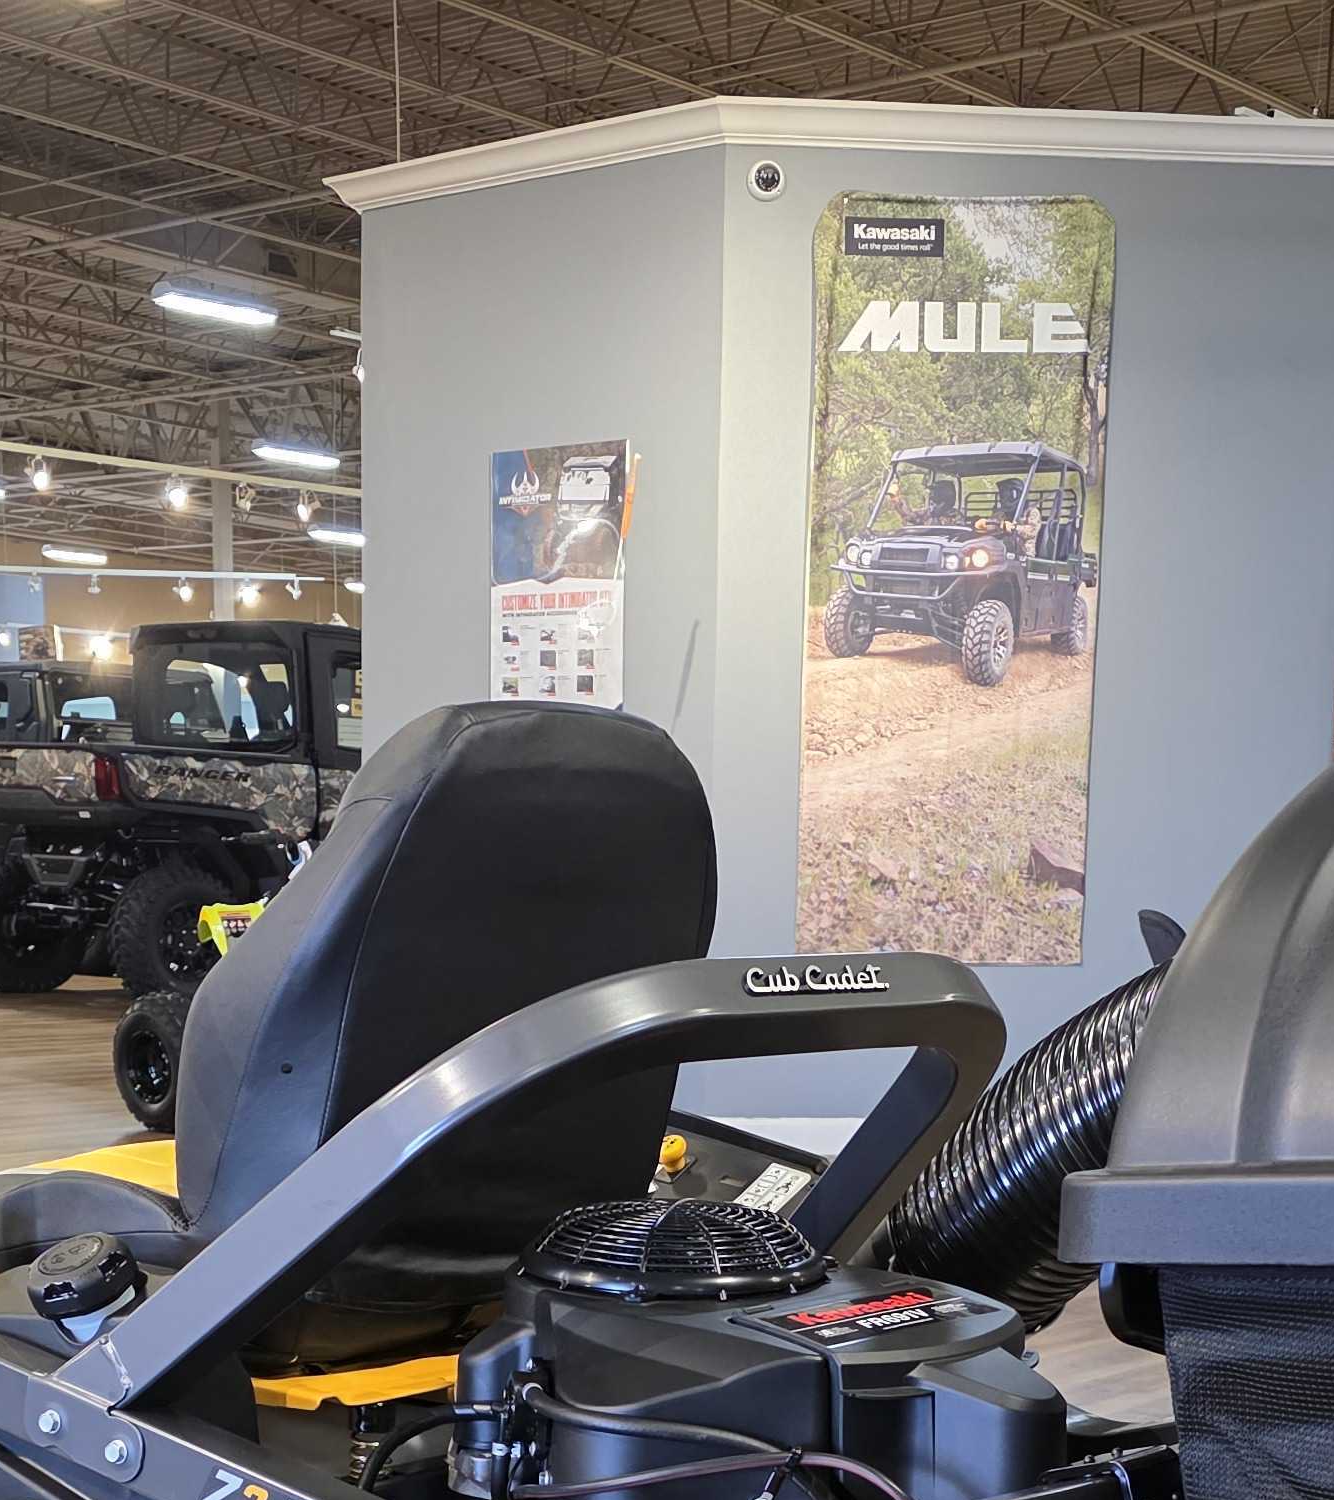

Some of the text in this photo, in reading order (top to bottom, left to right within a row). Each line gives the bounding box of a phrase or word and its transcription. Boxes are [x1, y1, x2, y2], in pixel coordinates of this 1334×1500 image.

[853, 223, 936, 240] Kawasaki
[870, 242, 881, 250] the
[882, 243, 899, 252] good
[838, 301, 1089, 353] MULE
[154, 765, 252, 783] RANGER
[745, 963, 890, 994] Cub Cadet
[787, 1291, 934, 1326] Kawasaki
[855, 1308, 930, 1329] FR691V
